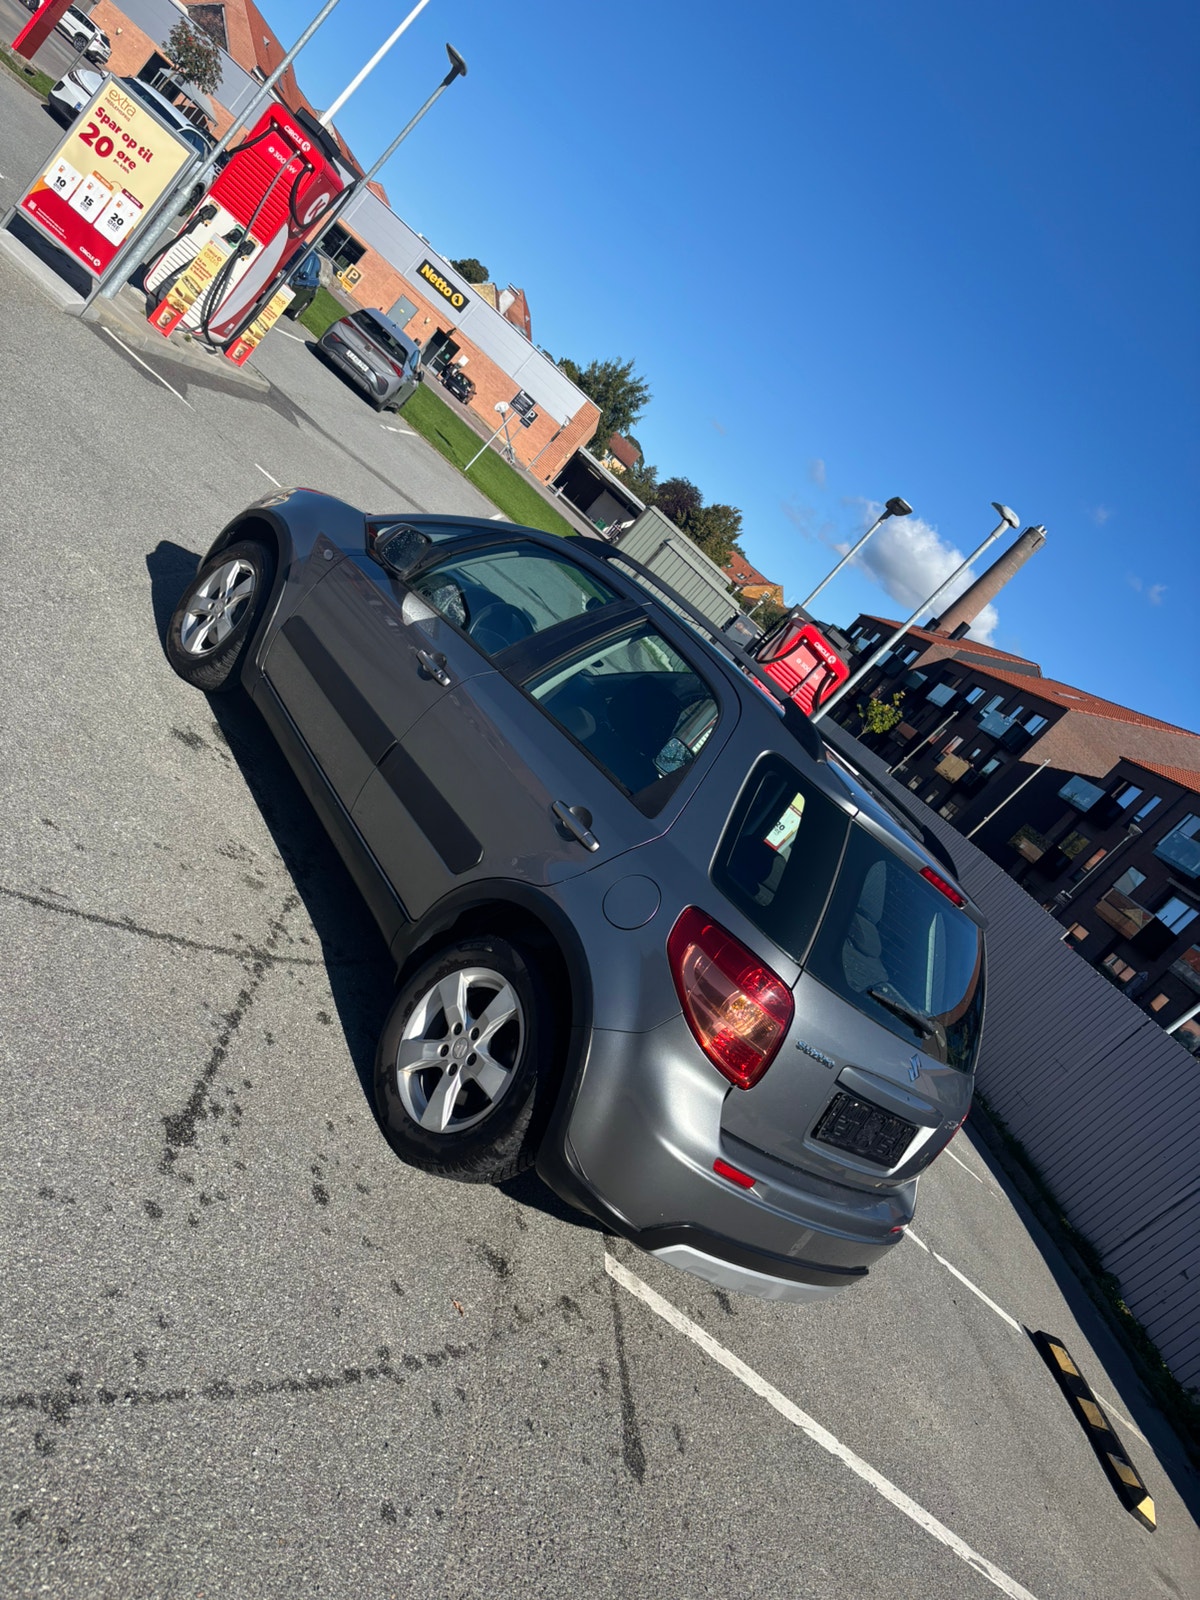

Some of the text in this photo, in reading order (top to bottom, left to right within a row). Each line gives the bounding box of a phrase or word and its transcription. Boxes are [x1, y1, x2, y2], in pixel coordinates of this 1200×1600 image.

[108, 89, 137, 118] extra
[95, 106, 154, 163] Spar op til
[284, 125, 310, 152] CIRCLE K
[78, 121, 136, 170] 20 øre
[273, 151, 287, 164] 300
[56, 176, 66, 187] 10
[84, 195, 94, 207] 15
[308, 198, 326, 219] K
[110, 212, 124, 226] 20
[79, 246, 95, 261] CIRCLE
[347, 269, 359, 280] P
[420, 263, 453, 297] Netto
[525, 409, 536, 420] P
[813, 641, 831, 658] CIRCLE
[776, 821, 785, 831] 20
[795, 1039, 836, 1070] SUZUKI
